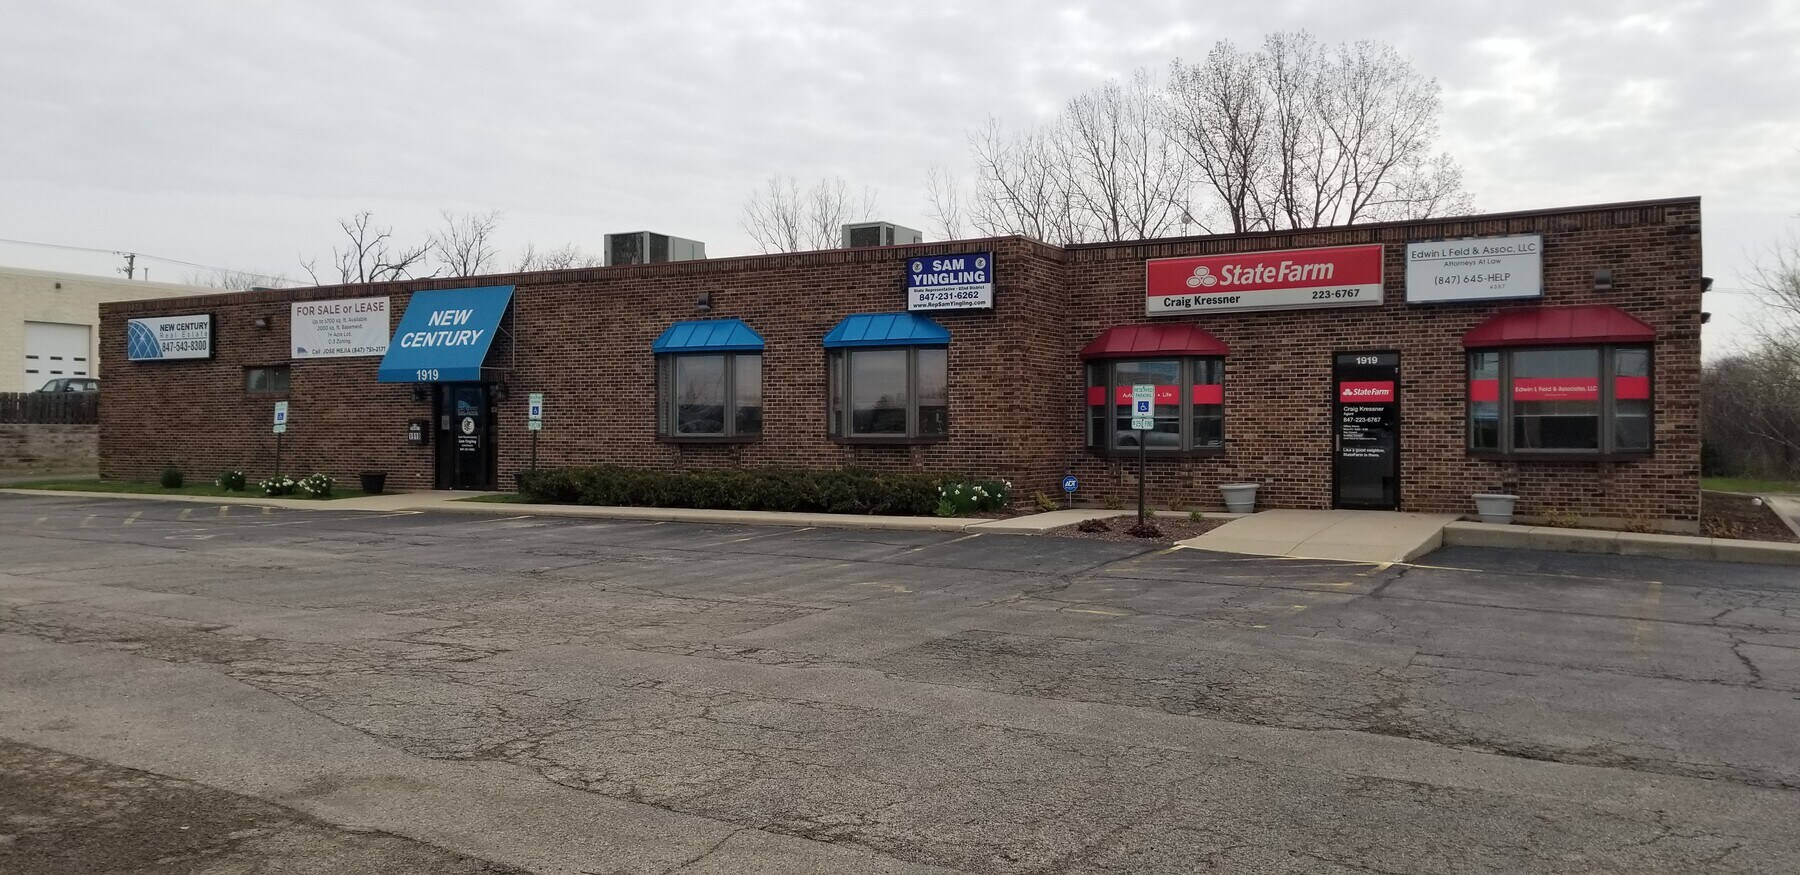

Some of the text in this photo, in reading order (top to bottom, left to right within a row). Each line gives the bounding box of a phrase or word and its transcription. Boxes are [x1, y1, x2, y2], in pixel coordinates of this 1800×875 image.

[1412, 250, 1439, 259] Edwin
[1449, 248, 1469, 256] Feld
[1518, 243, 1536, 252] LLC
[932, 259, 964, 271] SAM
[913, 271, 985, 285] YINGLING
[1434, 273, 1510, 286] (847) 645-HELP
[920, 291, 978, 301] 847-231-6262
[1163, 289, 1360, 308] Craig Kressner 223-6767
[297, 307, 315, 316] FOR
[318, 305, 340, 315] SALE
[355, 302, 384, 312] LEASE
[428, 309, 473, 326] NEW
[176, 322, 208, 331] CENTURY
[401, 330, 484, 348] CENTURY
[162, 341, 207, 352] 847-543-8300
[416, 369, 439, 380] 1919
